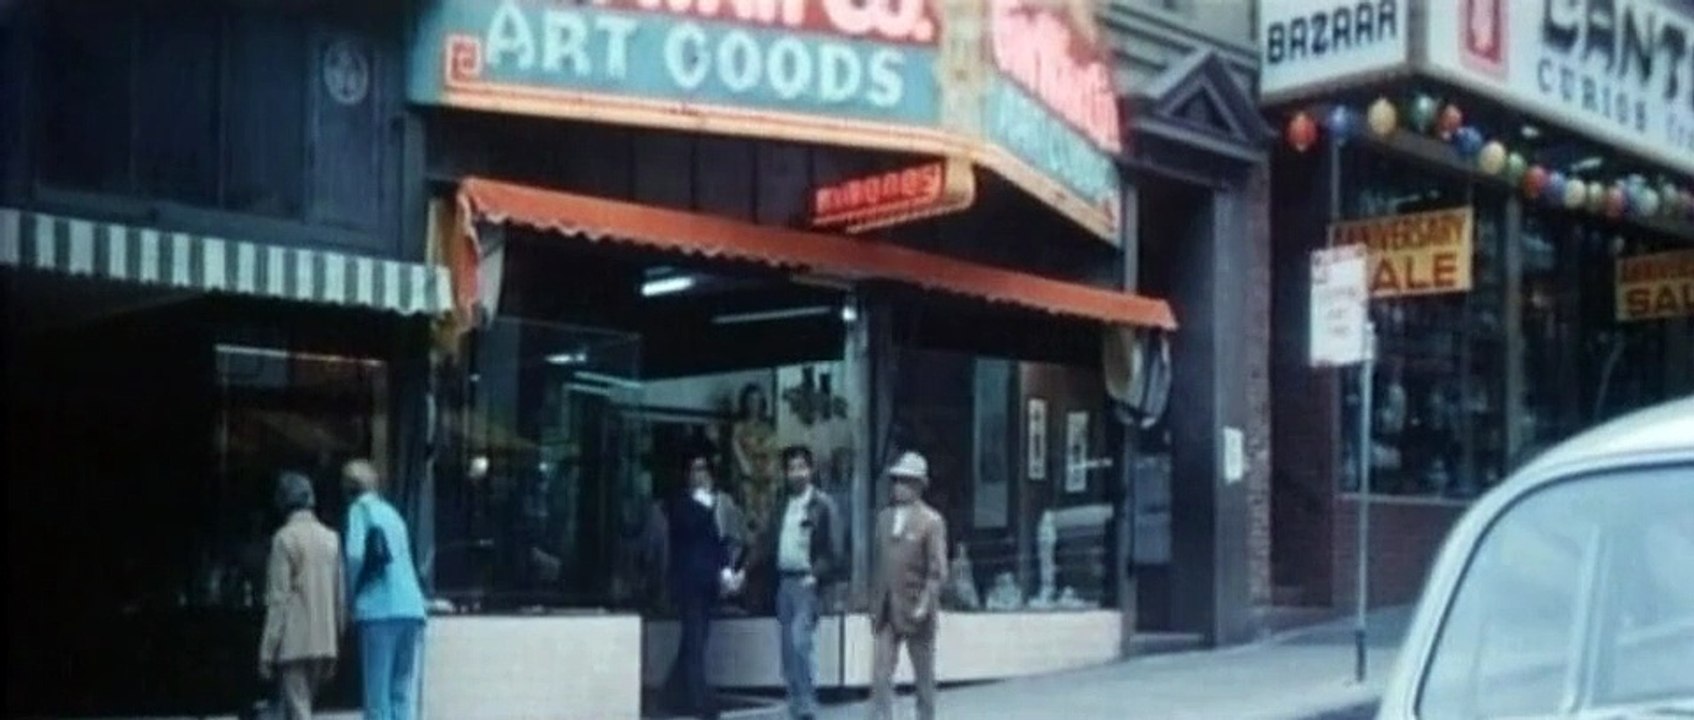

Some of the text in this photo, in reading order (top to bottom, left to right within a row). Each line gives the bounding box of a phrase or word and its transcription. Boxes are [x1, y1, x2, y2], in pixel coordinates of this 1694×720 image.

[486, 4, 637, 79] ART
[664, 22, 906, 107] GOODS
[1267, 0, 1397, 64] BAZAAR
[1543, 0, 1694, 111] CANT
[1371, 252, 1457, 293] ALE
